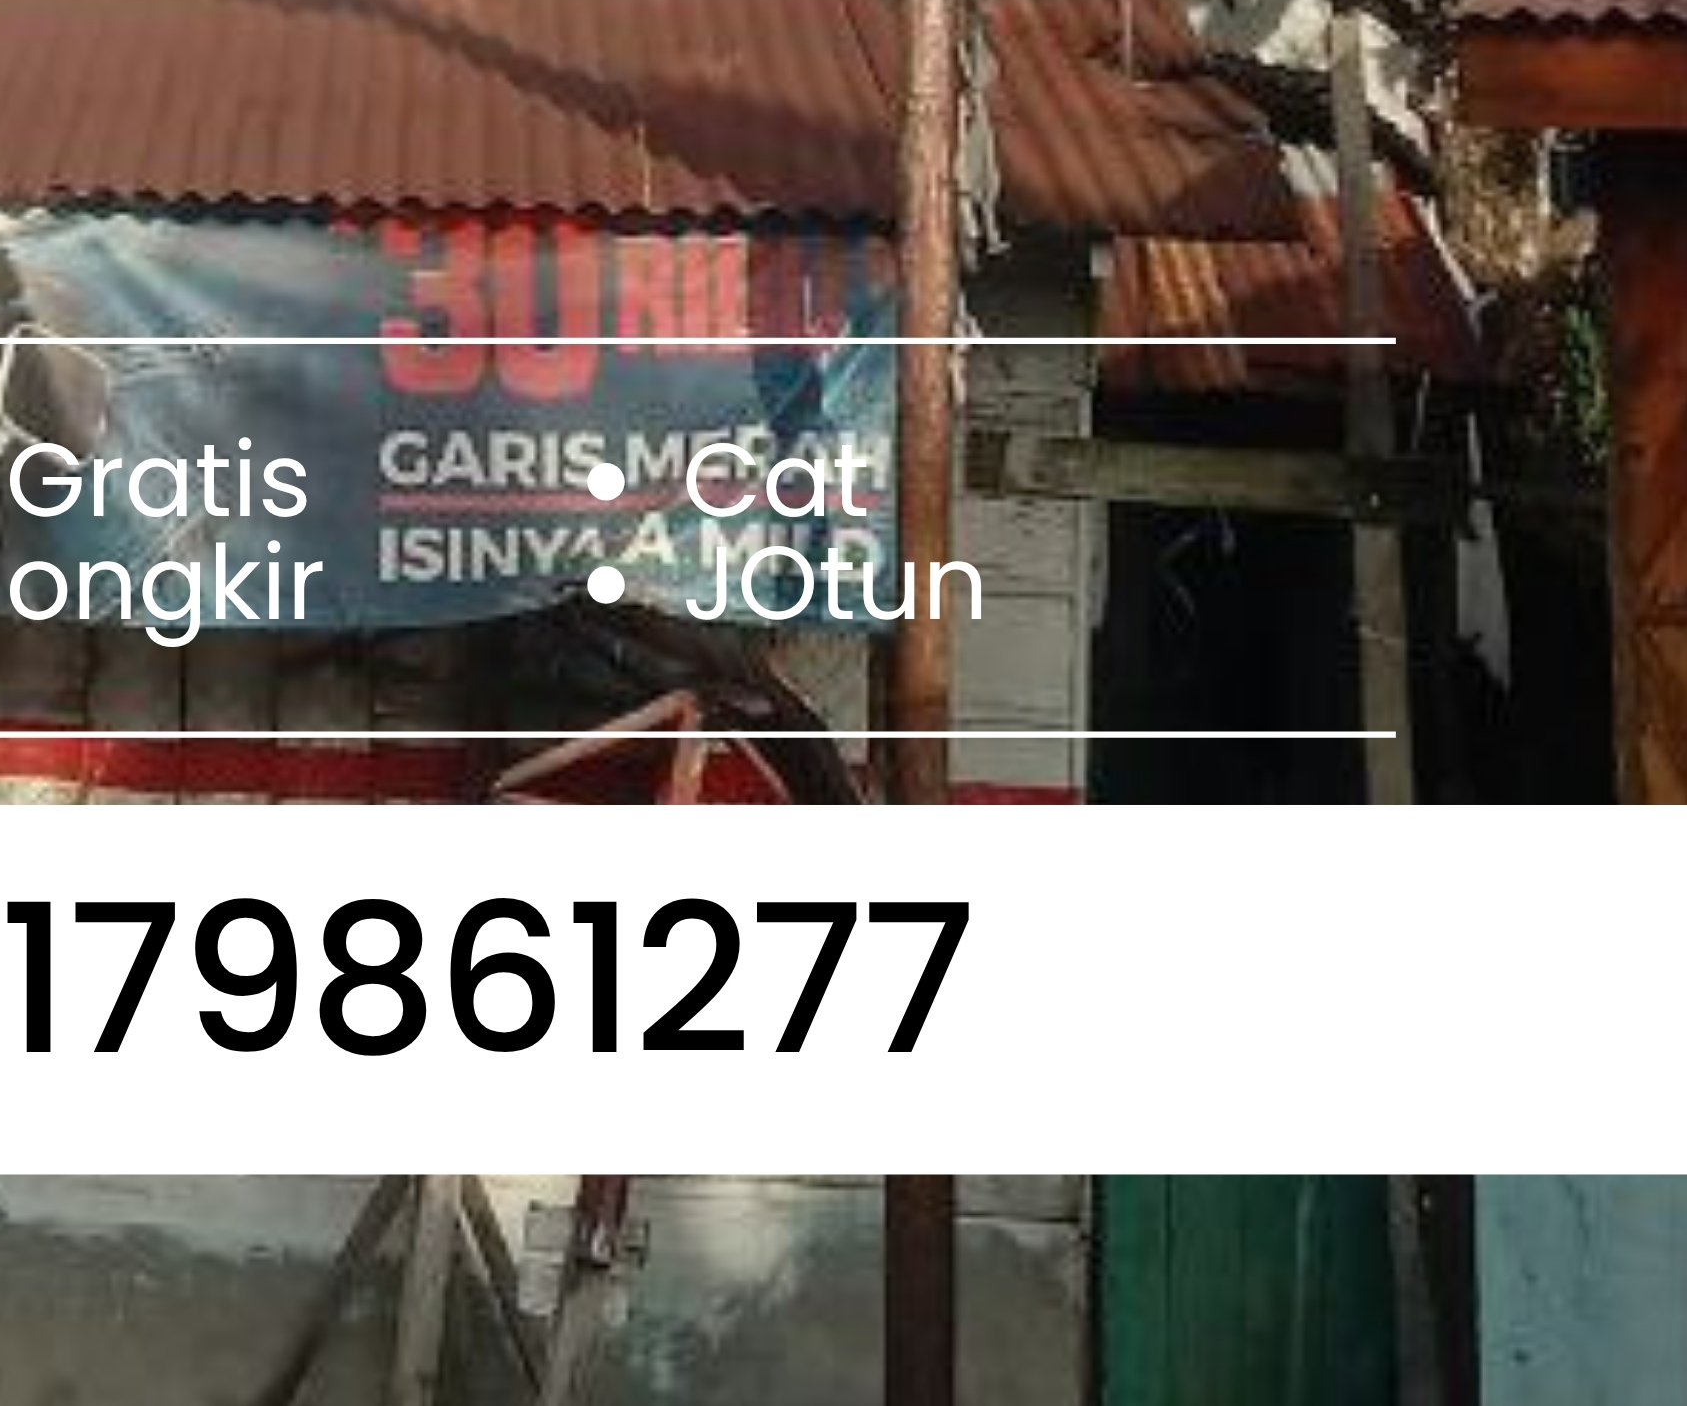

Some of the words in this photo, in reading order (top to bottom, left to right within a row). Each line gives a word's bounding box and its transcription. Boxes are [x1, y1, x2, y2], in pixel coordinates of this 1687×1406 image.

[378, 428, 606, 488] GARIS
[378, 527, 606, 582] ISINYA
[618, 511, 678, 566] A
